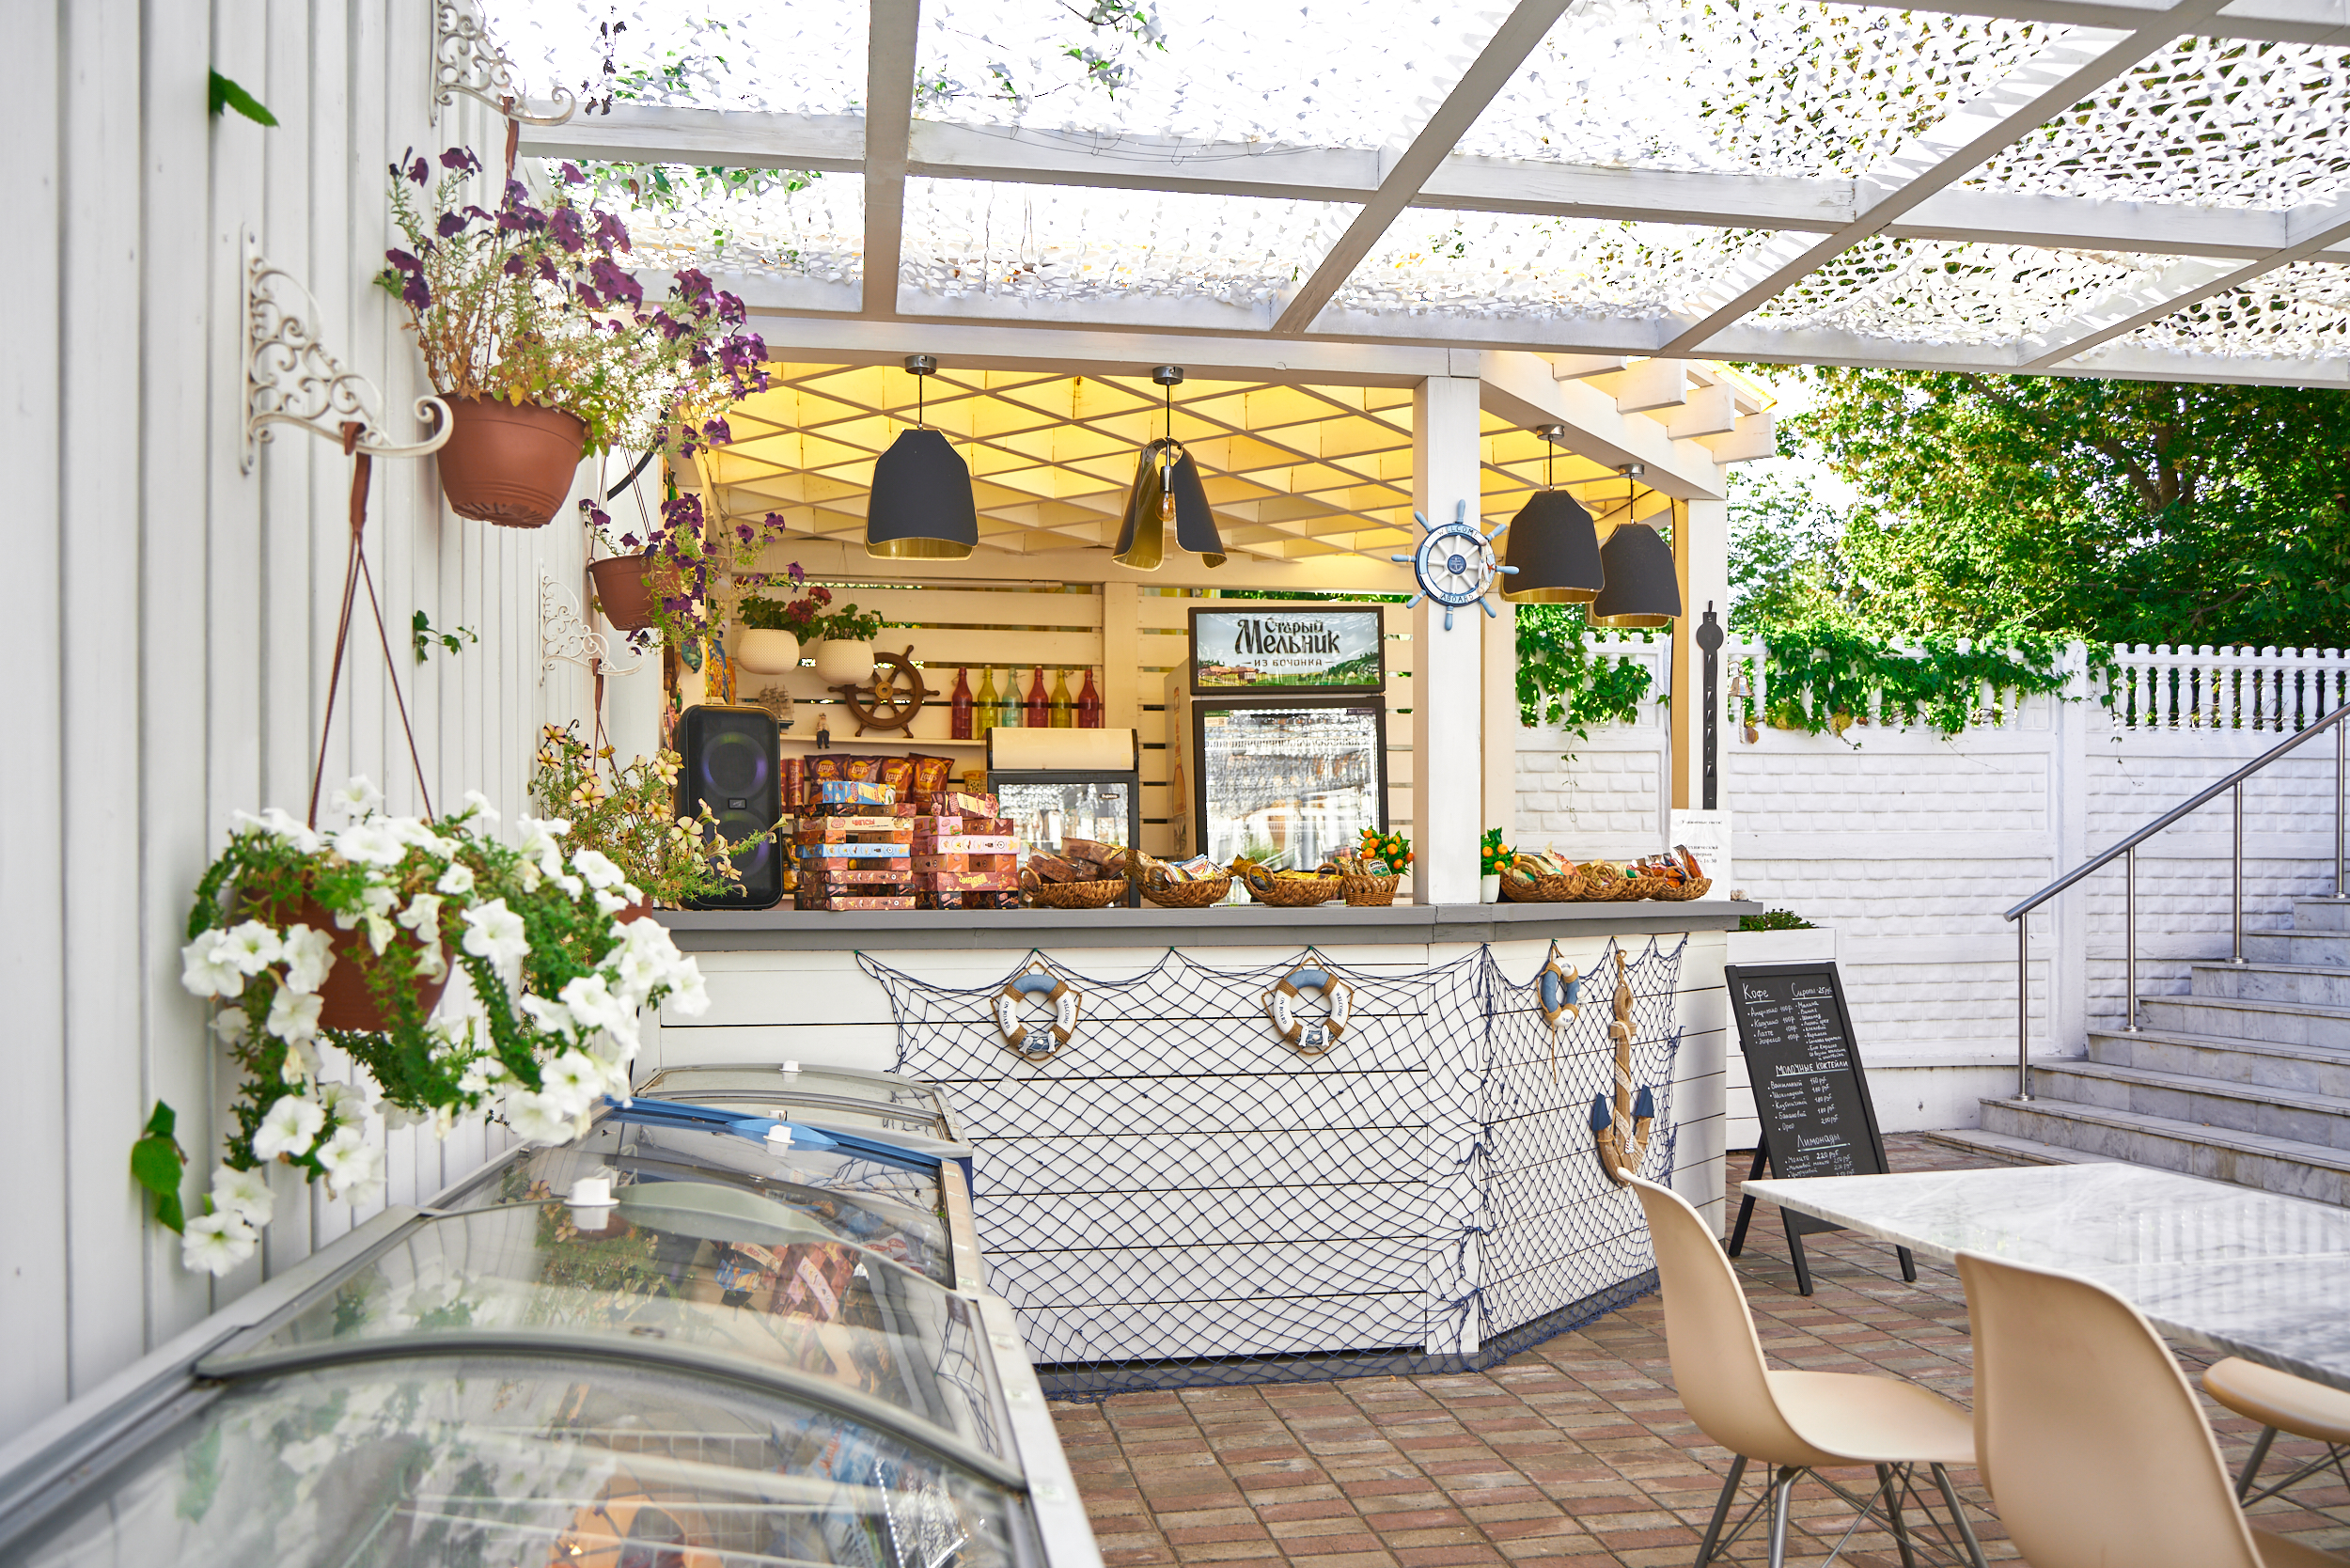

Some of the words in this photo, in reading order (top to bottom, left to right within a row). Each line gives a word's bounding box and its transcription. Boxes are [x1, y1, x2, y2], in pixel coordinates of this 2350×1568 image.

[1437, 525, 1479, 538] WLCOME
[1441, 593, 1474, 603] ABOARD
[1264, 618, 1324, 635] Старый
[1235, 619, 1340, 654] Мельник
[1743, 983, 1769, 1001] Кофе
[1791, 982, 1816, 998] Сиропы
[1004, 1000, 1010, 1009] ON
[1062, 998, 1071, 1025] WELCOME
[1336, 992, 1344, 1018] WELCOME
[1002, 1010, 1010, 1029] BOARD
[1278, 1006, 1288, 1025] BOARD
[1776, 1063, 1814, 1075] МОЛОЧНЫЕ
[1815, 1059, 1848, 1070] КОКТЕЙЛИ
[1797, 1134, 1841, 1147] Лимонады
[1816, 1152, 1828, 1160] 220
